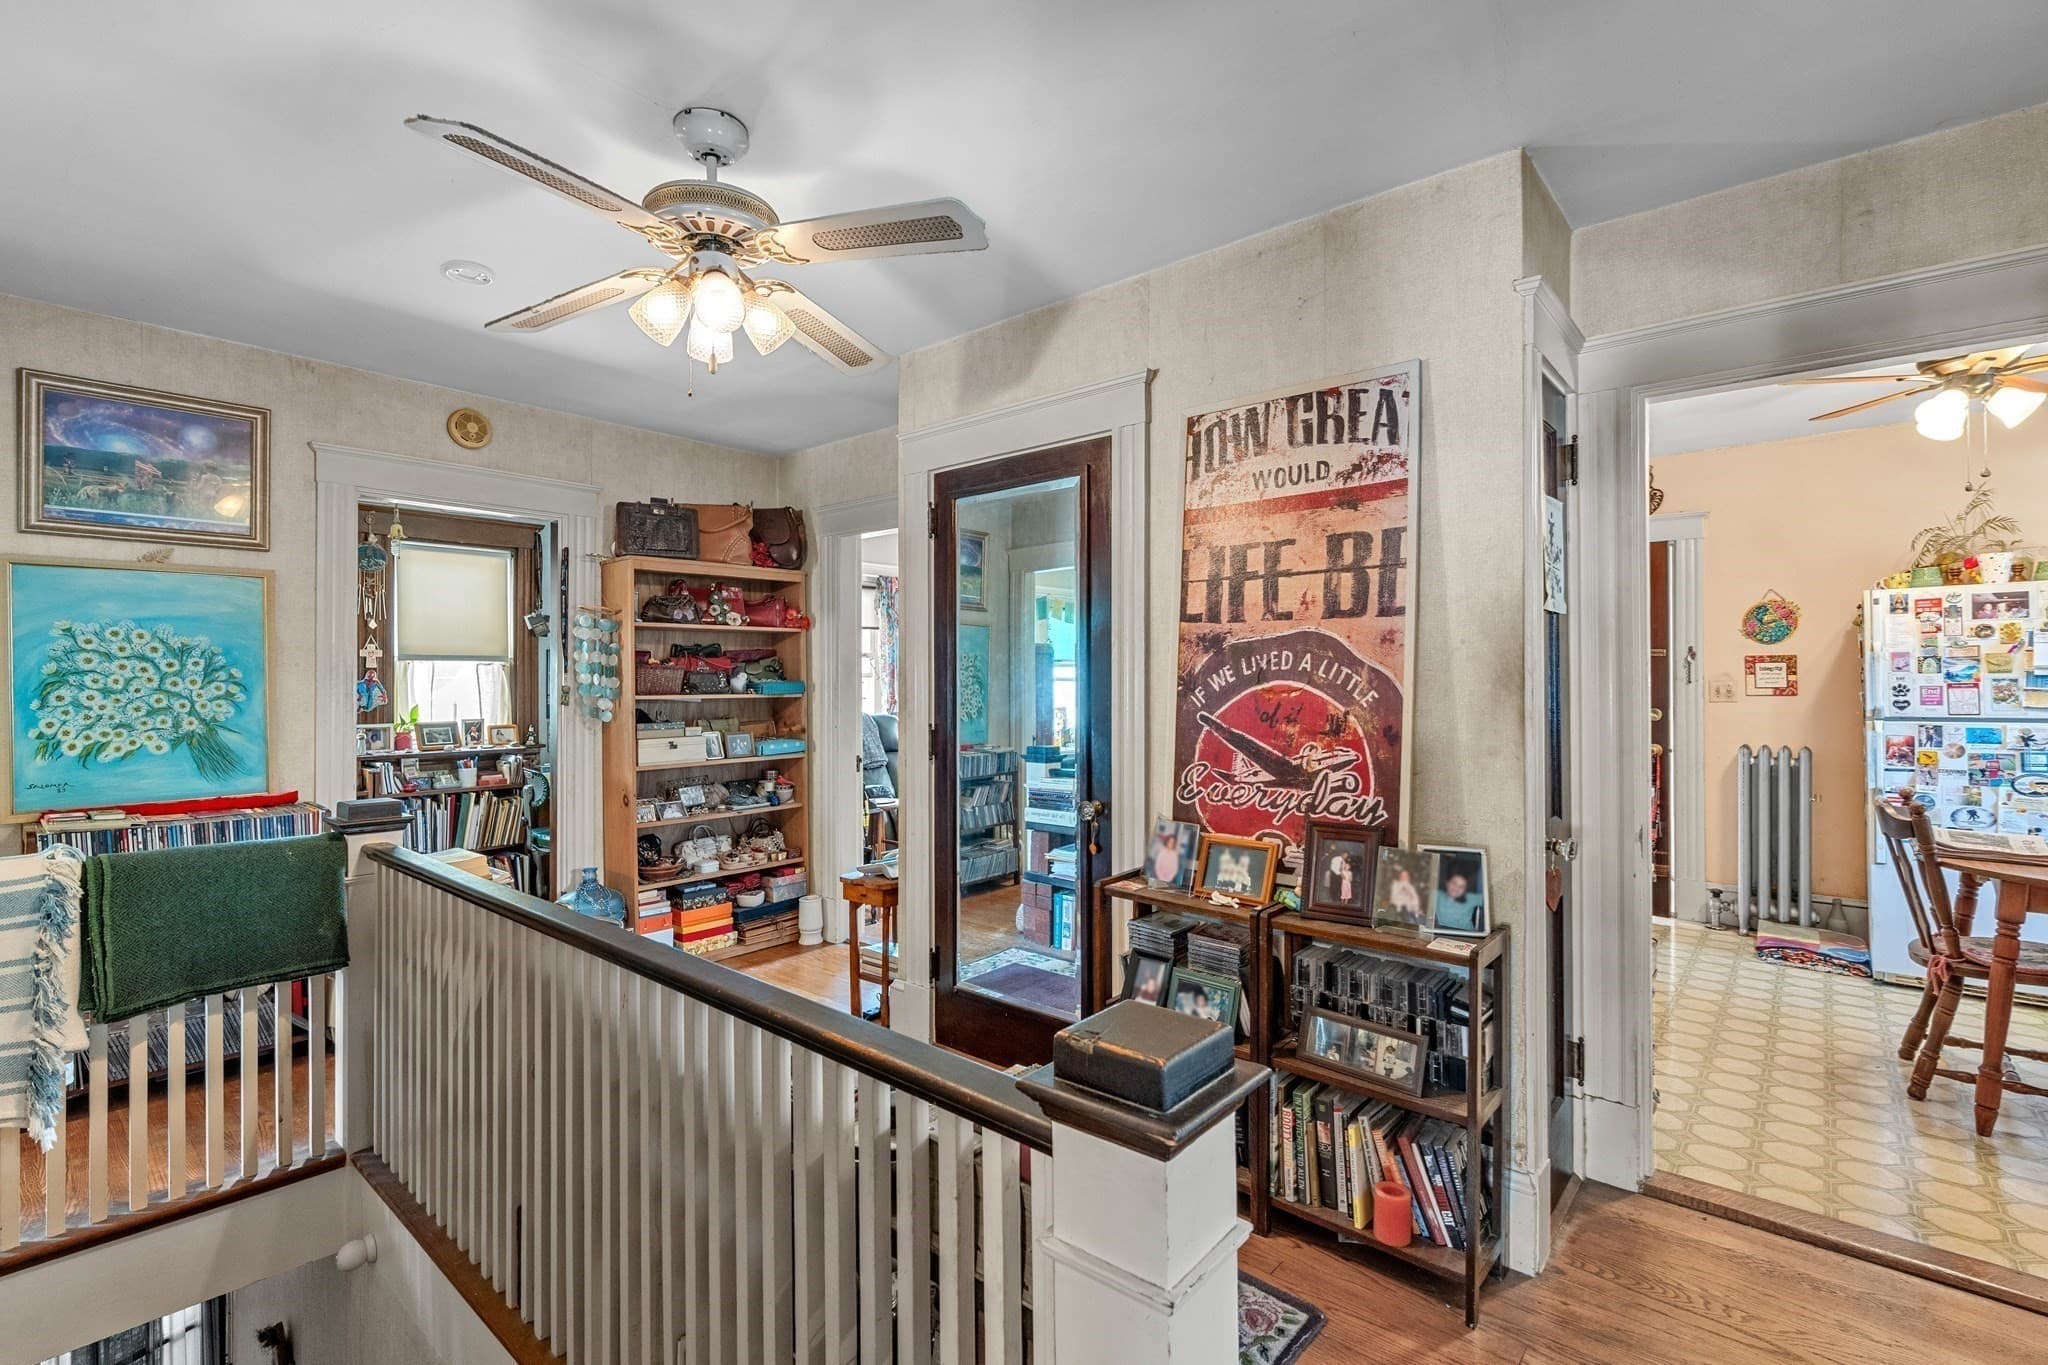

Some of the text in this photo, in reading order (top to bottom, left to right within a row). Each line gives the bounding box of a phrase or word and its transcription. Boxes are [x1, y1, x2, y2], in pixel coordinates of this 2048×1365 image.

[1285, 387, 1410, 449] GREA
[1252, 460, 1330, 489] WOULD
[1180, 526, 1406, 624] LIFE BE
[1190, 650, 1379, 708] IF WE LIVED A LITTLE
[1295, 1097, 1302, 1105] IN
[1295, 1106, 1302, 1118] MY
[1282, 1109, 1292, 1143] BOOTY
[1296, 1118, 1304, 1153] KITCHEN
[1441, 1211, 1456, 1227] CAT
